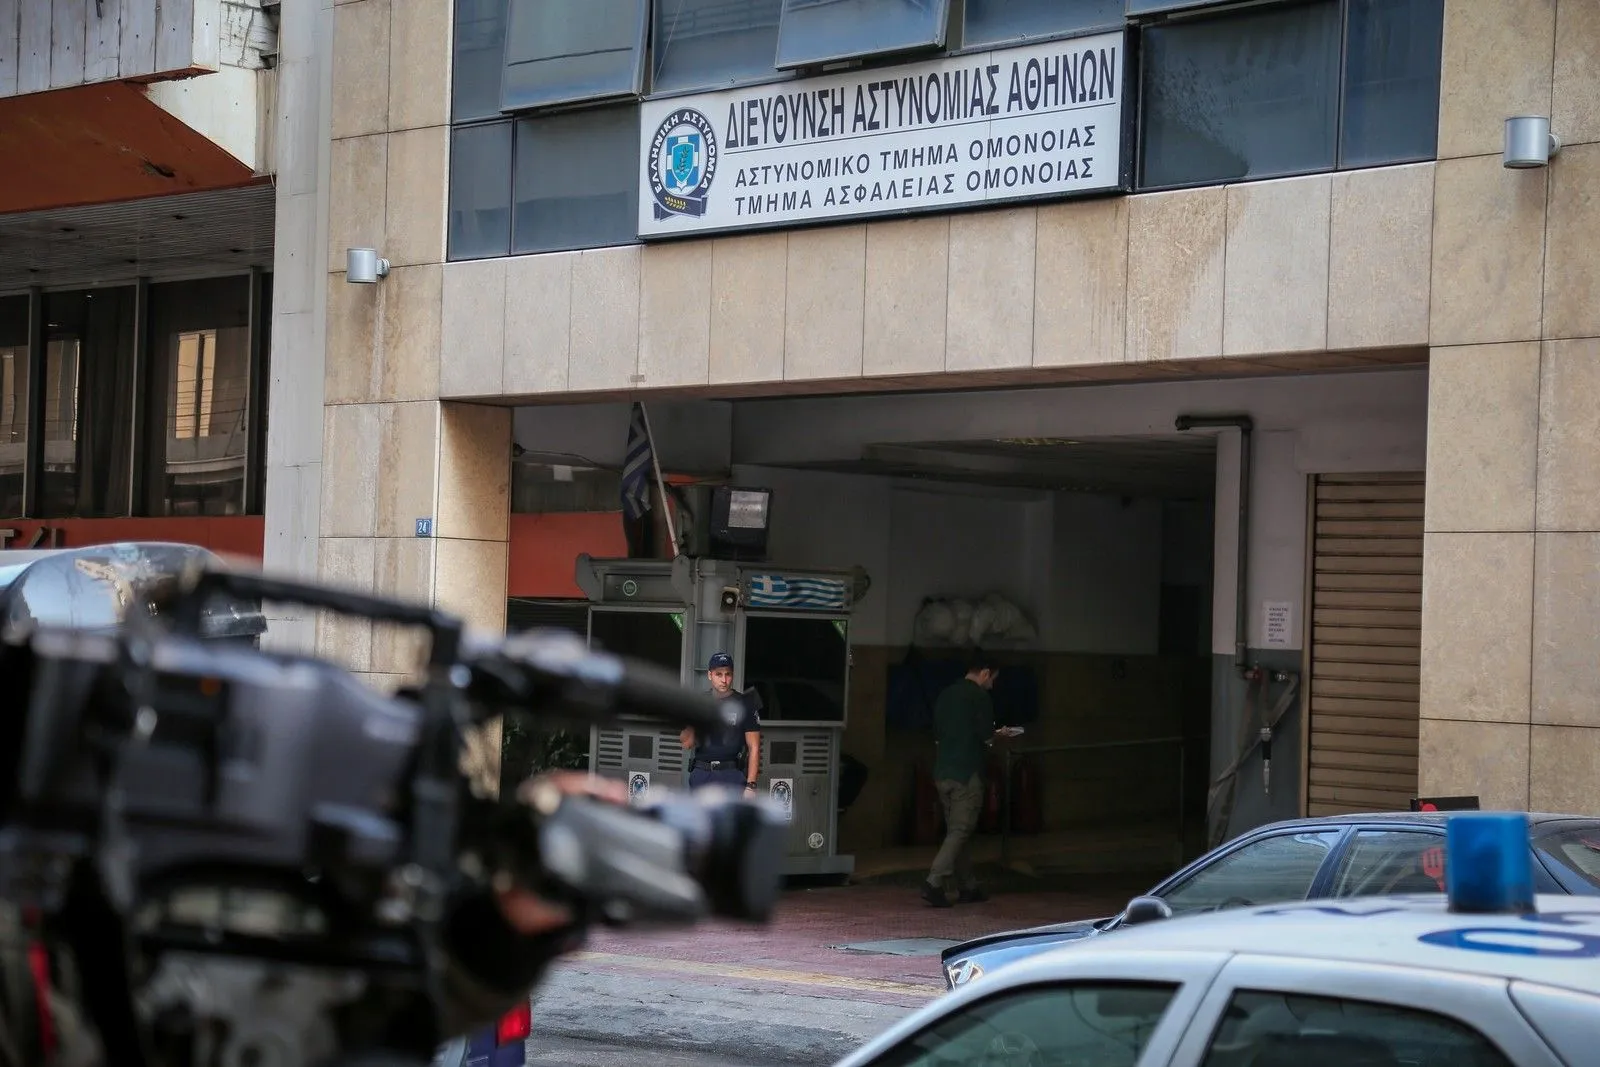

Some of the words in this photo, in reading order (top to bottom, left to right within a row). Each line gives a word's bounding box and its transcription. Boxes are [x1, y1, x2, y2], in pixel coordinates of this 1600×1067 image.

[725, 87, 845, 149] ΔΙΕΥΘΥΝΣΗ
[852, 64, 1000, 133] ΑΣΤΥΝΟΜΙΑΣ
[1006, 46, 1117, 112] ΑΘΗΝΩΝ
[735, 153, 870, 188] ΑΣΤΥΝΟΜΙΚΟ
[880, 143, 958, 170] ΤΜΗΜΑ
[968, 125, 1096, 161] ΟΜΟΝΟΙΑΣ
[735, 187, 812, 216] ΤΜΗΜΑ
[823, 172, 955, 206] ΑΣΦΑΛΕΙΑΣ
[966, 156, 1094, 192] ΟΜΟΝΟΙΑΣ
